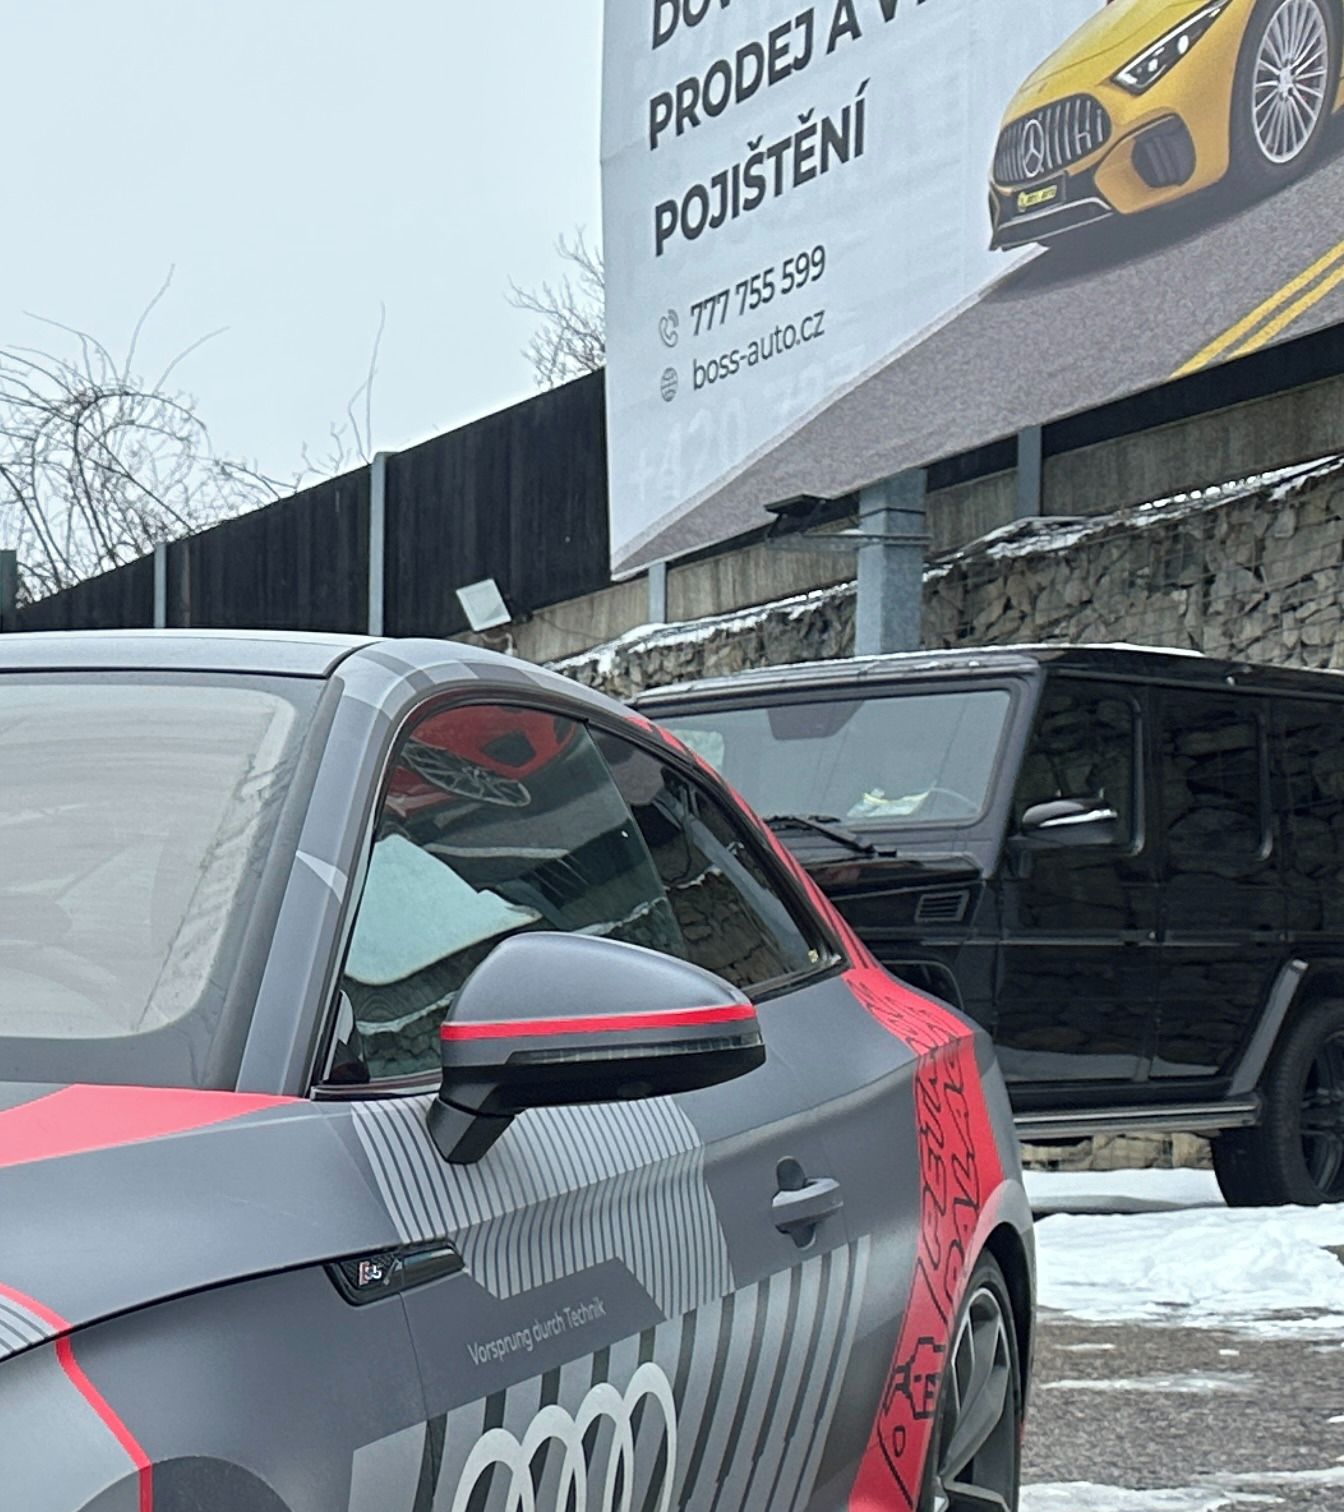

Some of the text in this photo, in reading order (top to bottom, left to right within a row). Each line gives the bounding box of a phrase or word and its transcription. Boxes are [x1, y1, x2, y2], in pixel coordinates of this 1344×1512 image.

[649, 7, 814, 151] PRODEJ
[655, 76, 871, 258] POJIŠTĚNÍ
[690, 245, 826, 337] 777 755 599
[692, 309, 826, 391] boss-auto.cz
[467, 1296, 607, 1366] Vorsprung durch Technik
